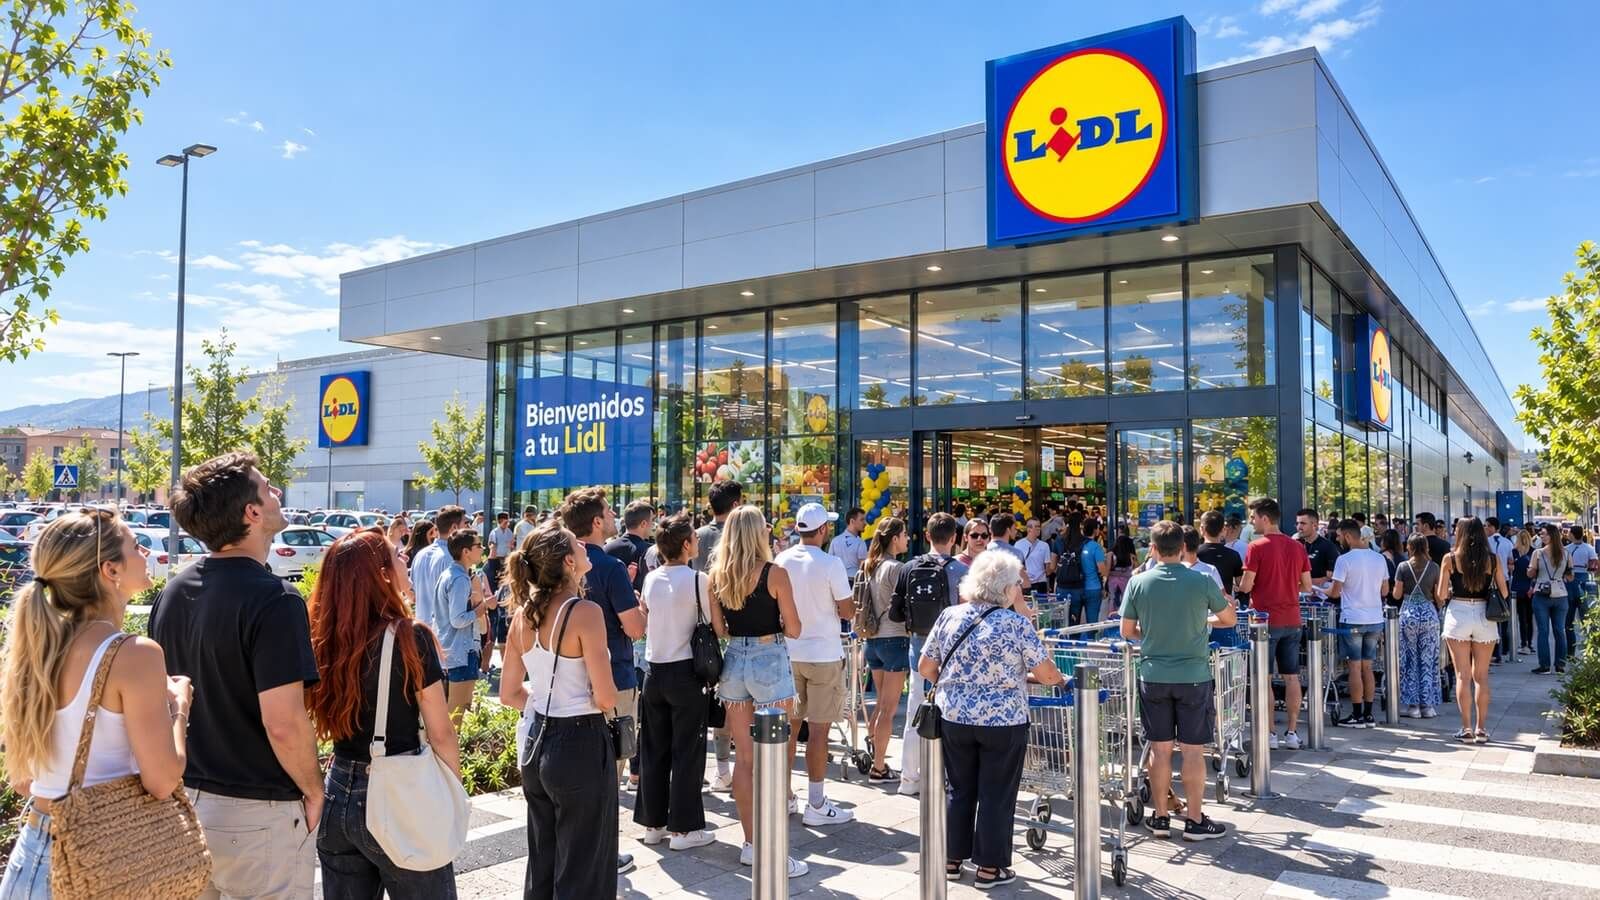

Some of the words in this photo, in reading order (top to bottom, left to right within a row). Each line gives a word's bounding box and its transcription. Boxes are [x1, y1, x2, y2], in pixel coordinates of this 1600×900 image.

[526, 391, 645, 427] Bienvenidos
[525, 438, 535, 457] a
[540, 433, 559, 456] tu
[564, 421, 607, 454] Lidl
